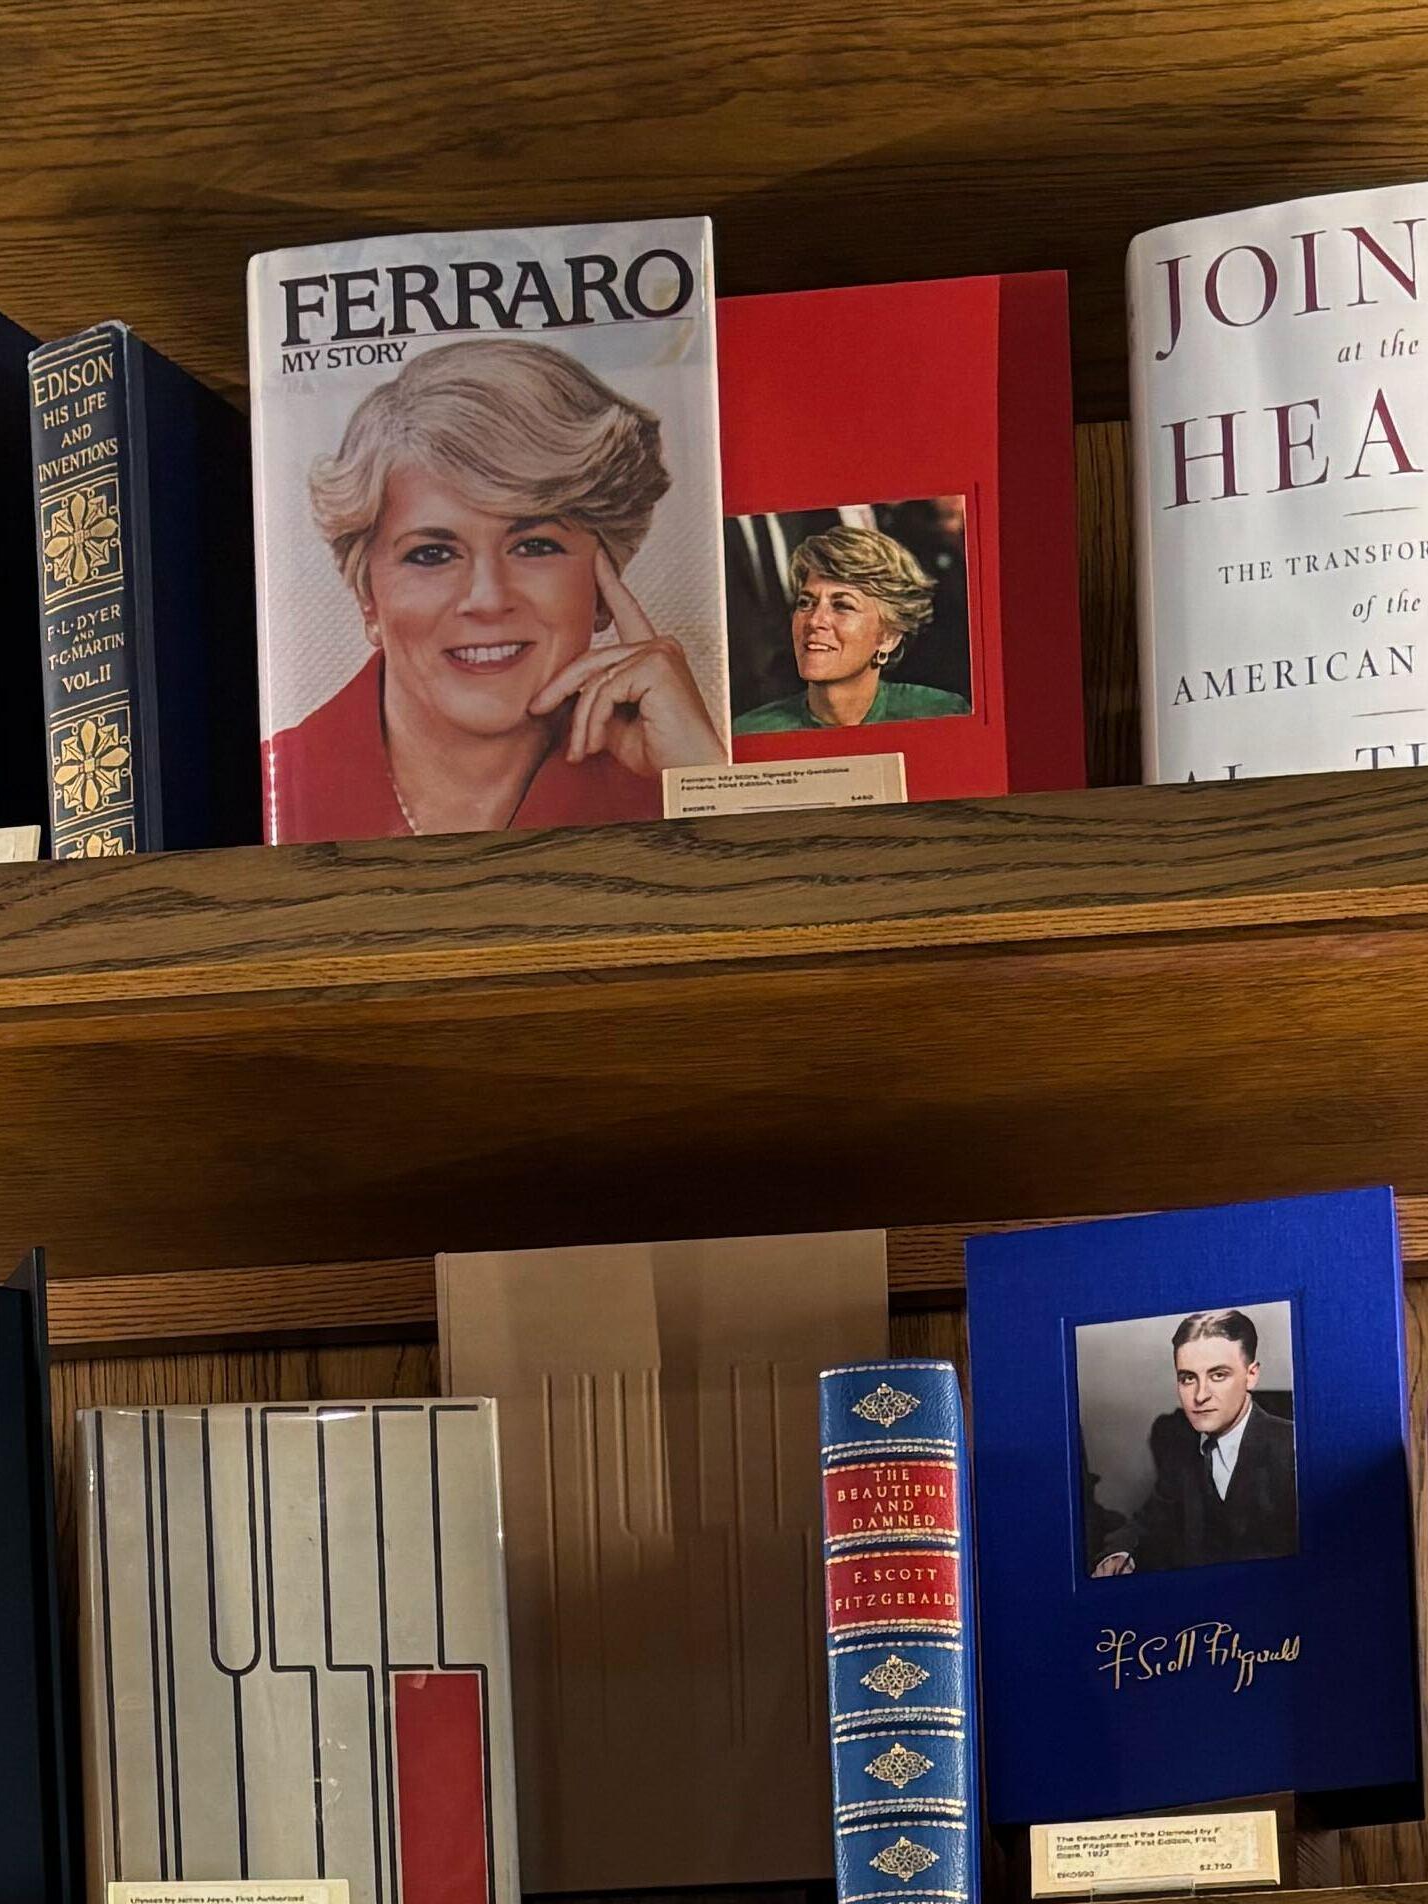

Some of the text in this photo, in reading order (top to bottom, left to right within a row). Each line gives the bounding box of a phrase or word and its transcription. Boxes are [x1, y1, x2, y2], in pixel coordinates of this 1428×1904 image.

[279, 248, 696, 349] FERRARO
[280, 342, 407, 375] MY STORY
[1337, 331, 1420, 366] at the
[32, 354, 114, 408] EDISON
[38, 438, 118, 480] INVENTIONS
[1219, 562, 1273, 586] THE
[1352, 591, 1421, 623] of the
[1171, 644, 1415, 707] AMERICAN
[873, 1468, 910, 1481] THE
[838, 1485, 946, 1502] BEAUTIFUL
[873, 1499, 915, 1514] AND
[853, 1514, 936, 1529] DAMNED
[854, 1567, 937, 1585] F. SCOTT
[835, 1591, 955, 1611] FITZGERALD
